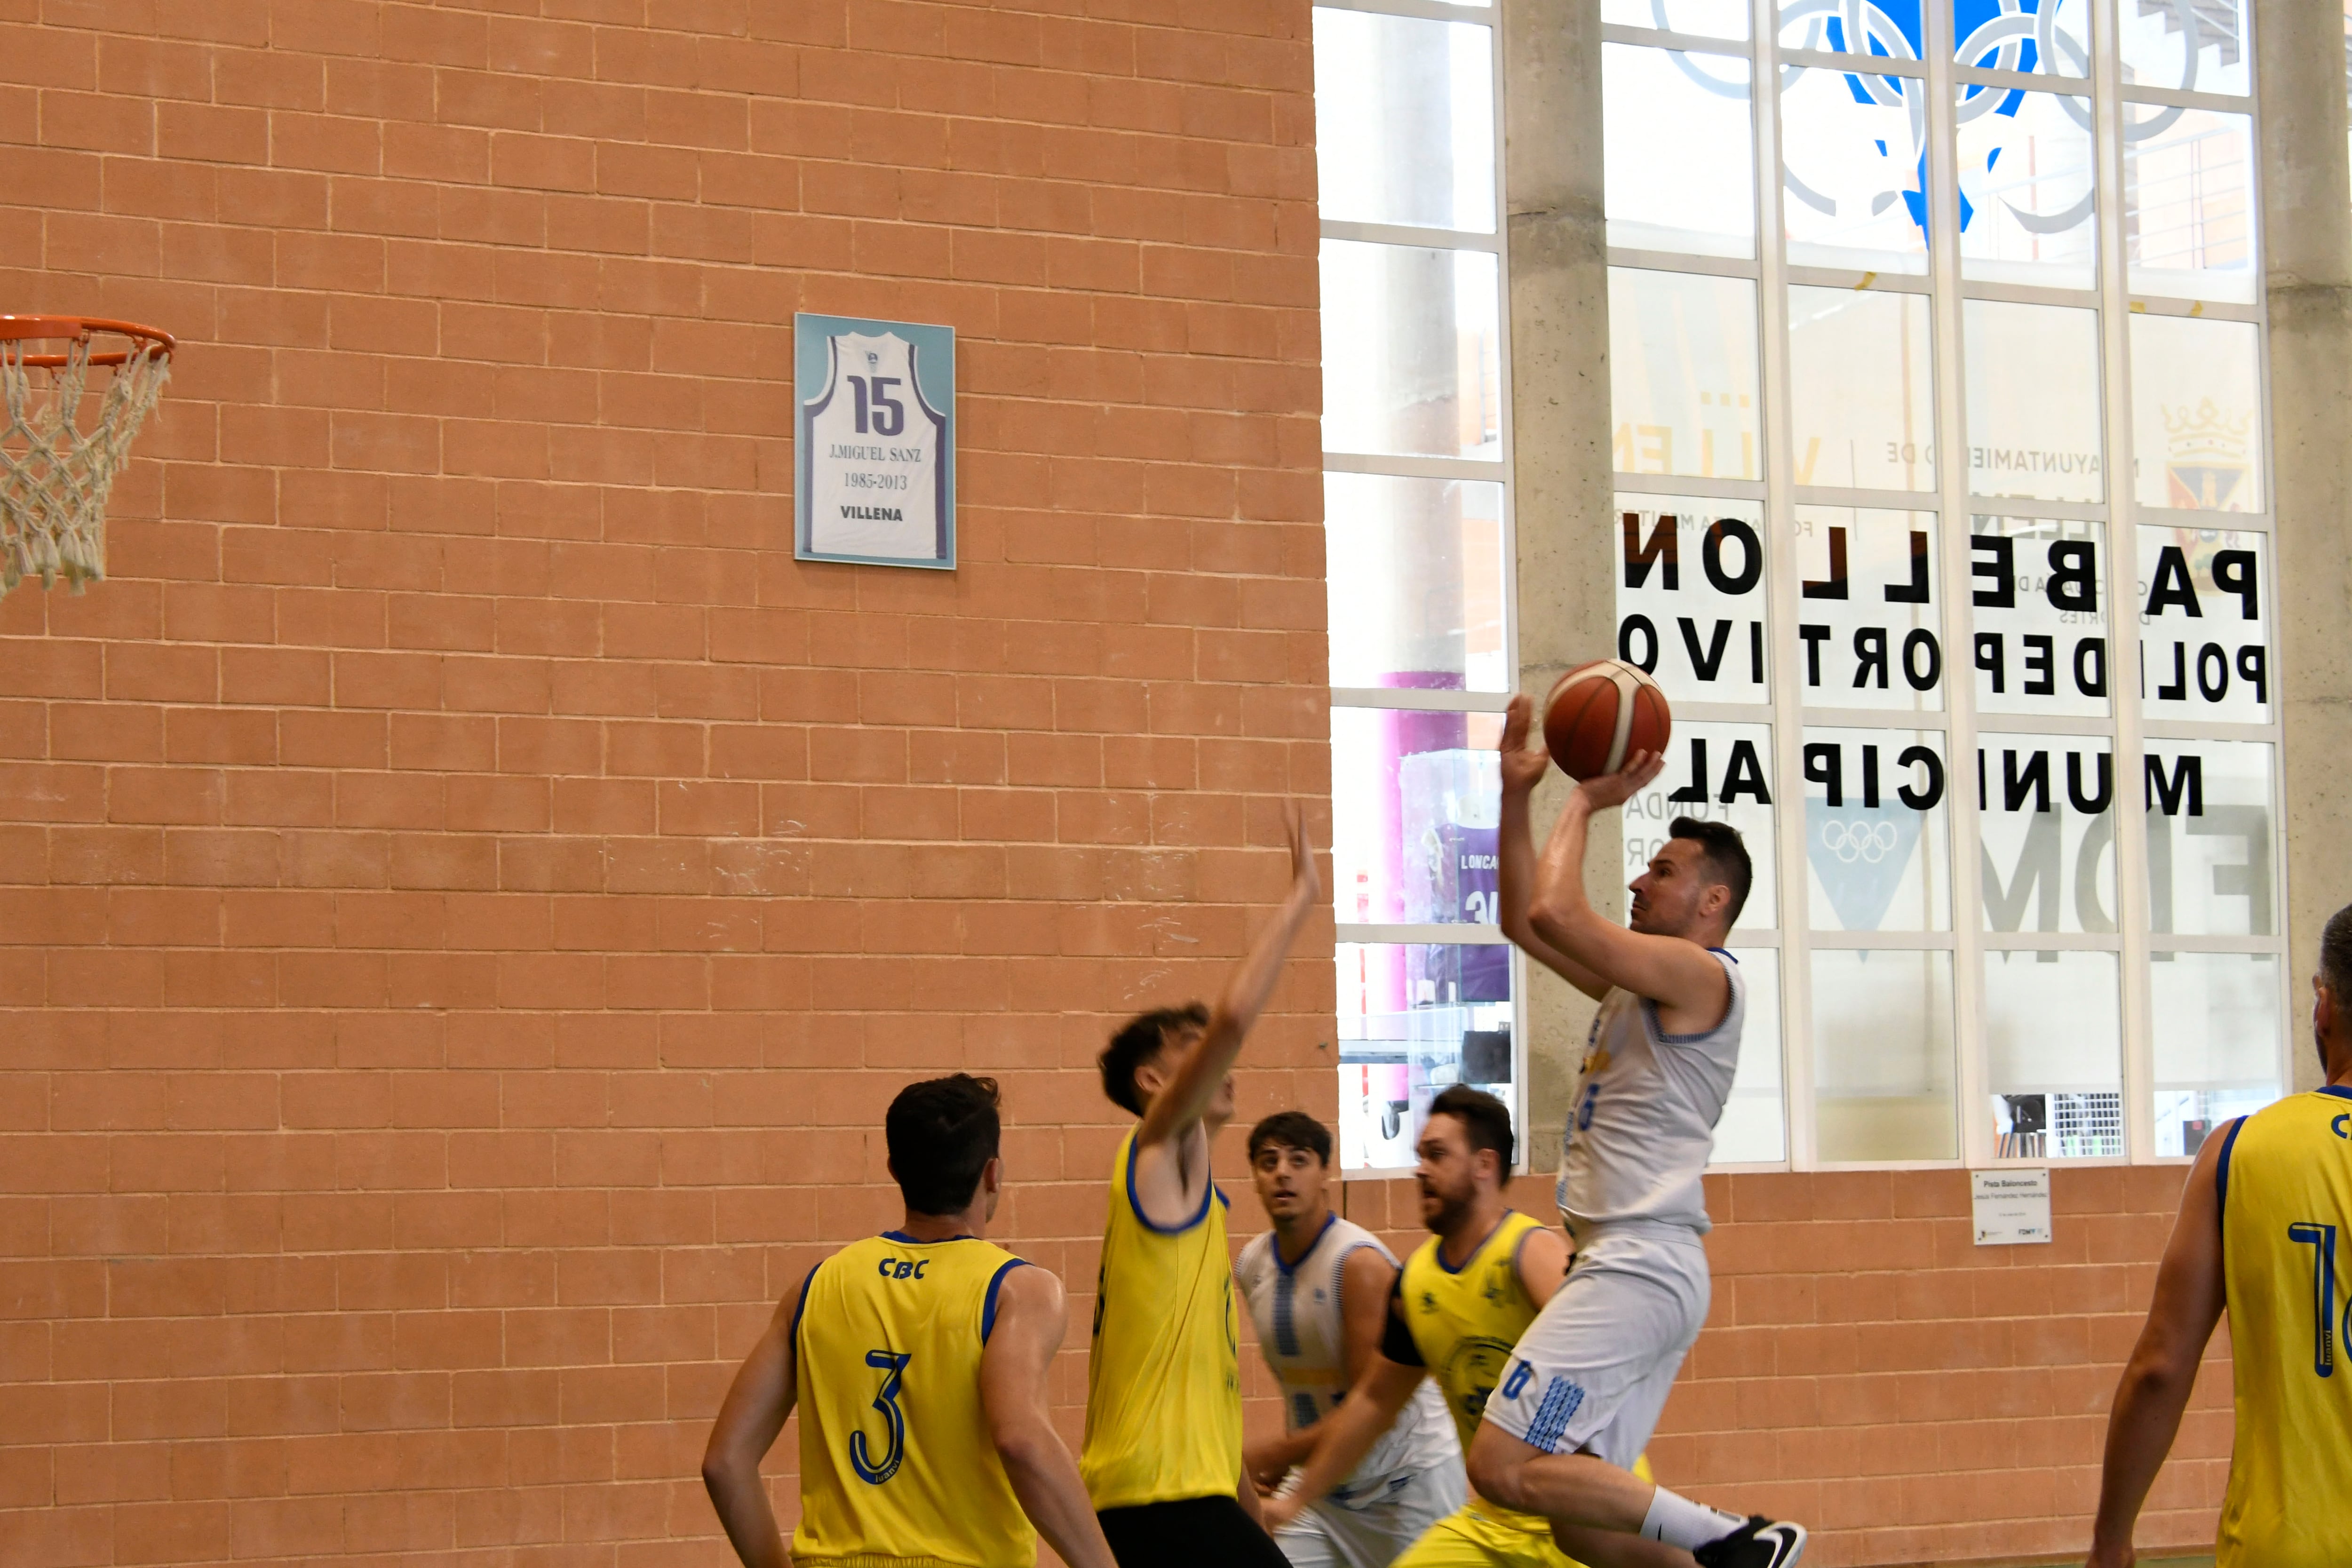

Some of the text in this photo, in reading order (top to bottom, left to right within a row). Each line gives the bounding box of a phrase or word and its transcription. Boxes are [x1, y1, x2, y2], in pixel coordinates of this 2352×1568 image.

[847, 375, 904, 436] 15
[829, 444, 922, 462] J.MIGUEL SANZ
[844, 472, 907, 490] 1985-2013
[840, 505, 903, 521] VILLENA
[1461, 855, 1500, 869] LONCA
[2331, 1113, 2352, 1140] C
[879, 1258, 930, 1280] CBC
[2288, 1222, 2352, 1377] 1
[850, 1349, 911, 1485] 3
